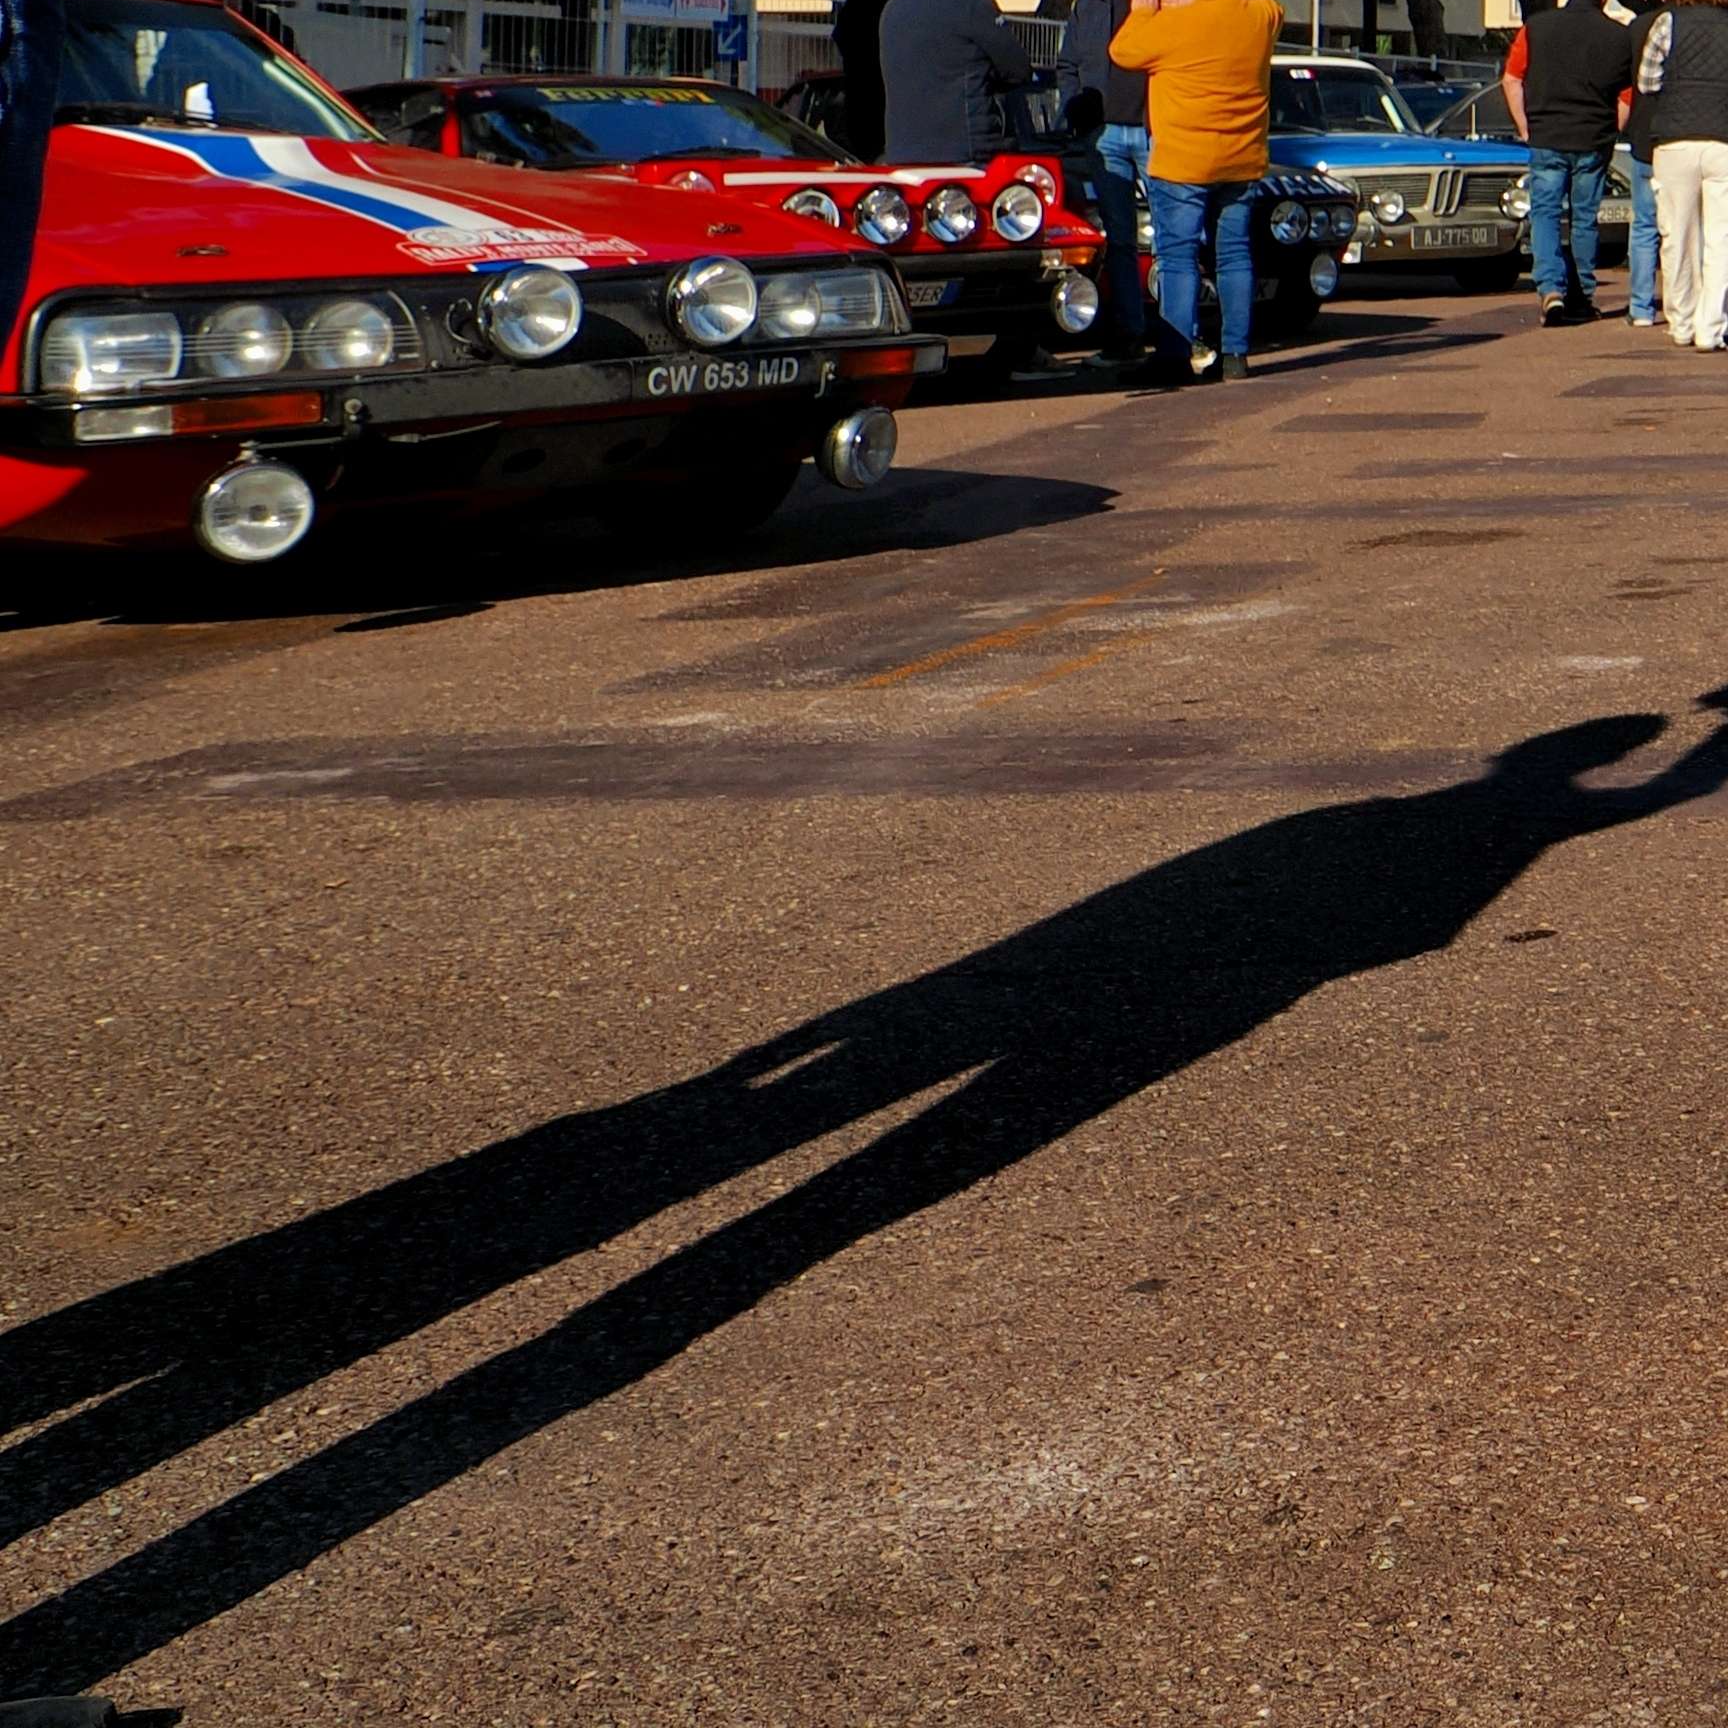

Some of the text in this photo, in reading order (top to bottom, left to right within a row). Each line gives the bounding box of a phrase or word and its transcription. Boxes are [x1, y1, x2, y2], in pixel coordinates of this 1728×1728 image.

[648, 357, 799, 396] CW 653 MD
